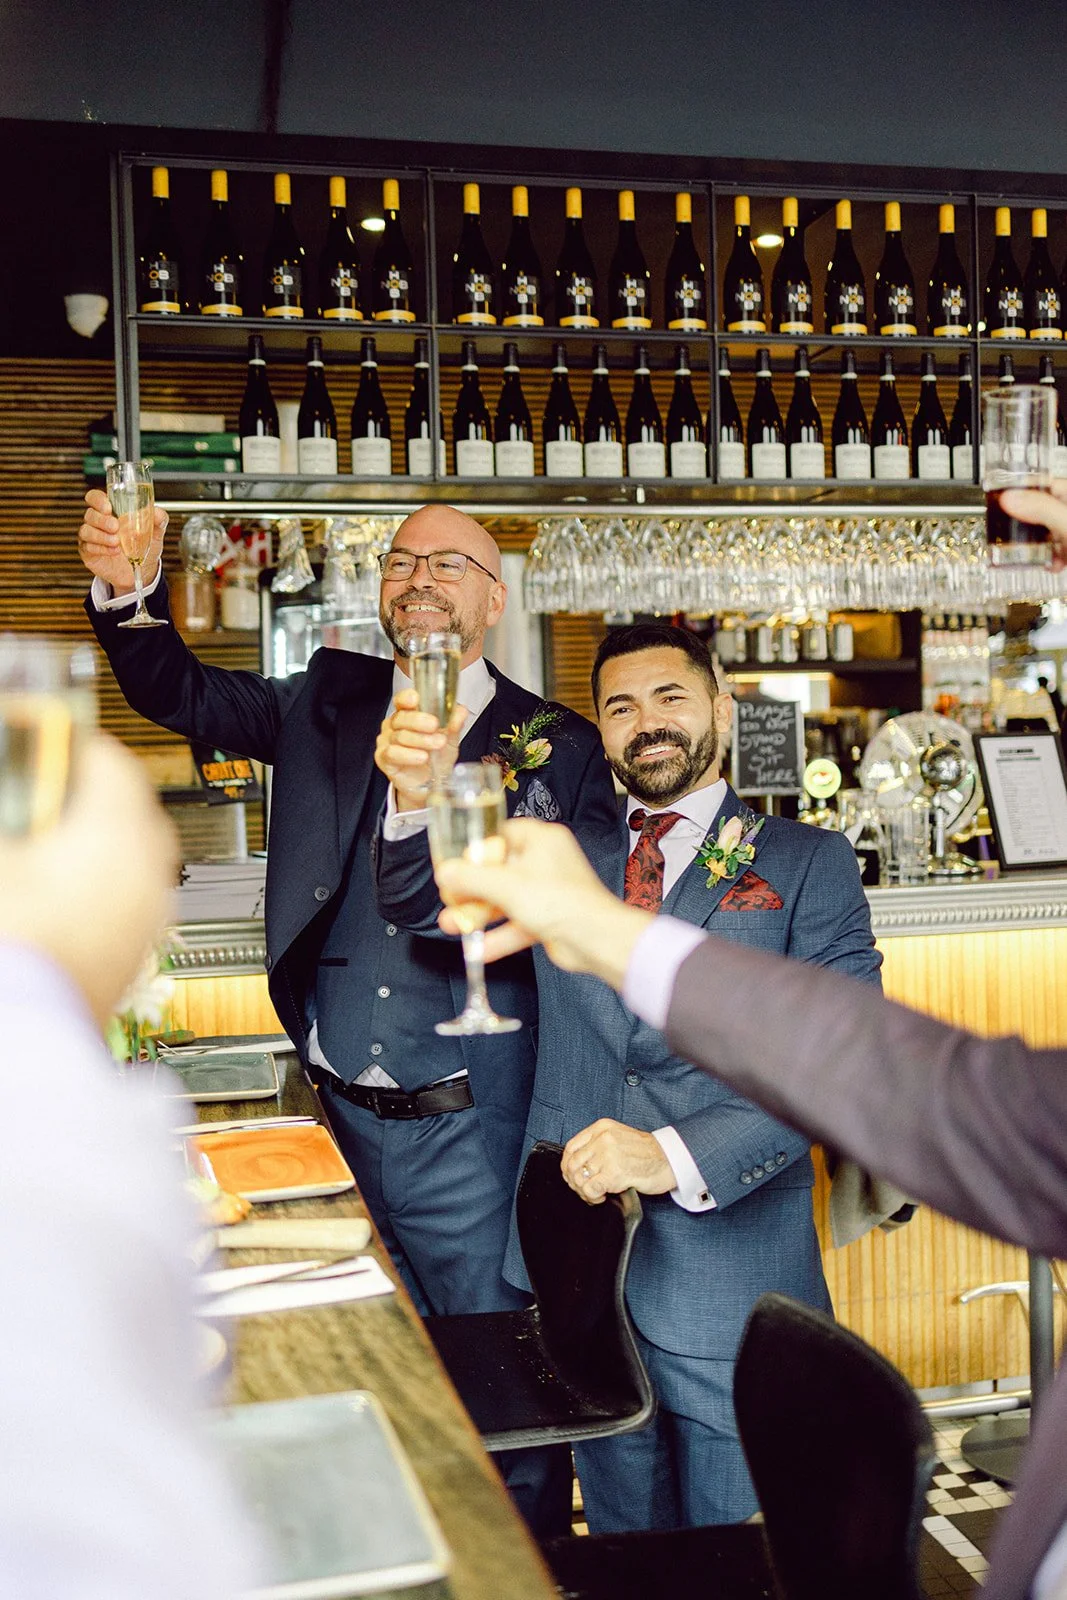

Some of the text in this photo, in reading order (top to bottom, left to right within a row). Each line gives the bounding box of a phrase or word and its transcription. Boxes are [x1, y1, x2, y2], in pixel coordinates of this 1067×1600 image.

[739, 702, 794, 720] PLEASE
[739, 718, 795, 732] DO NOT
[739, 732, 786, 752] STAND
[748, 754, 785, 771] SIT
[756, 768, 796, 785] HERE
